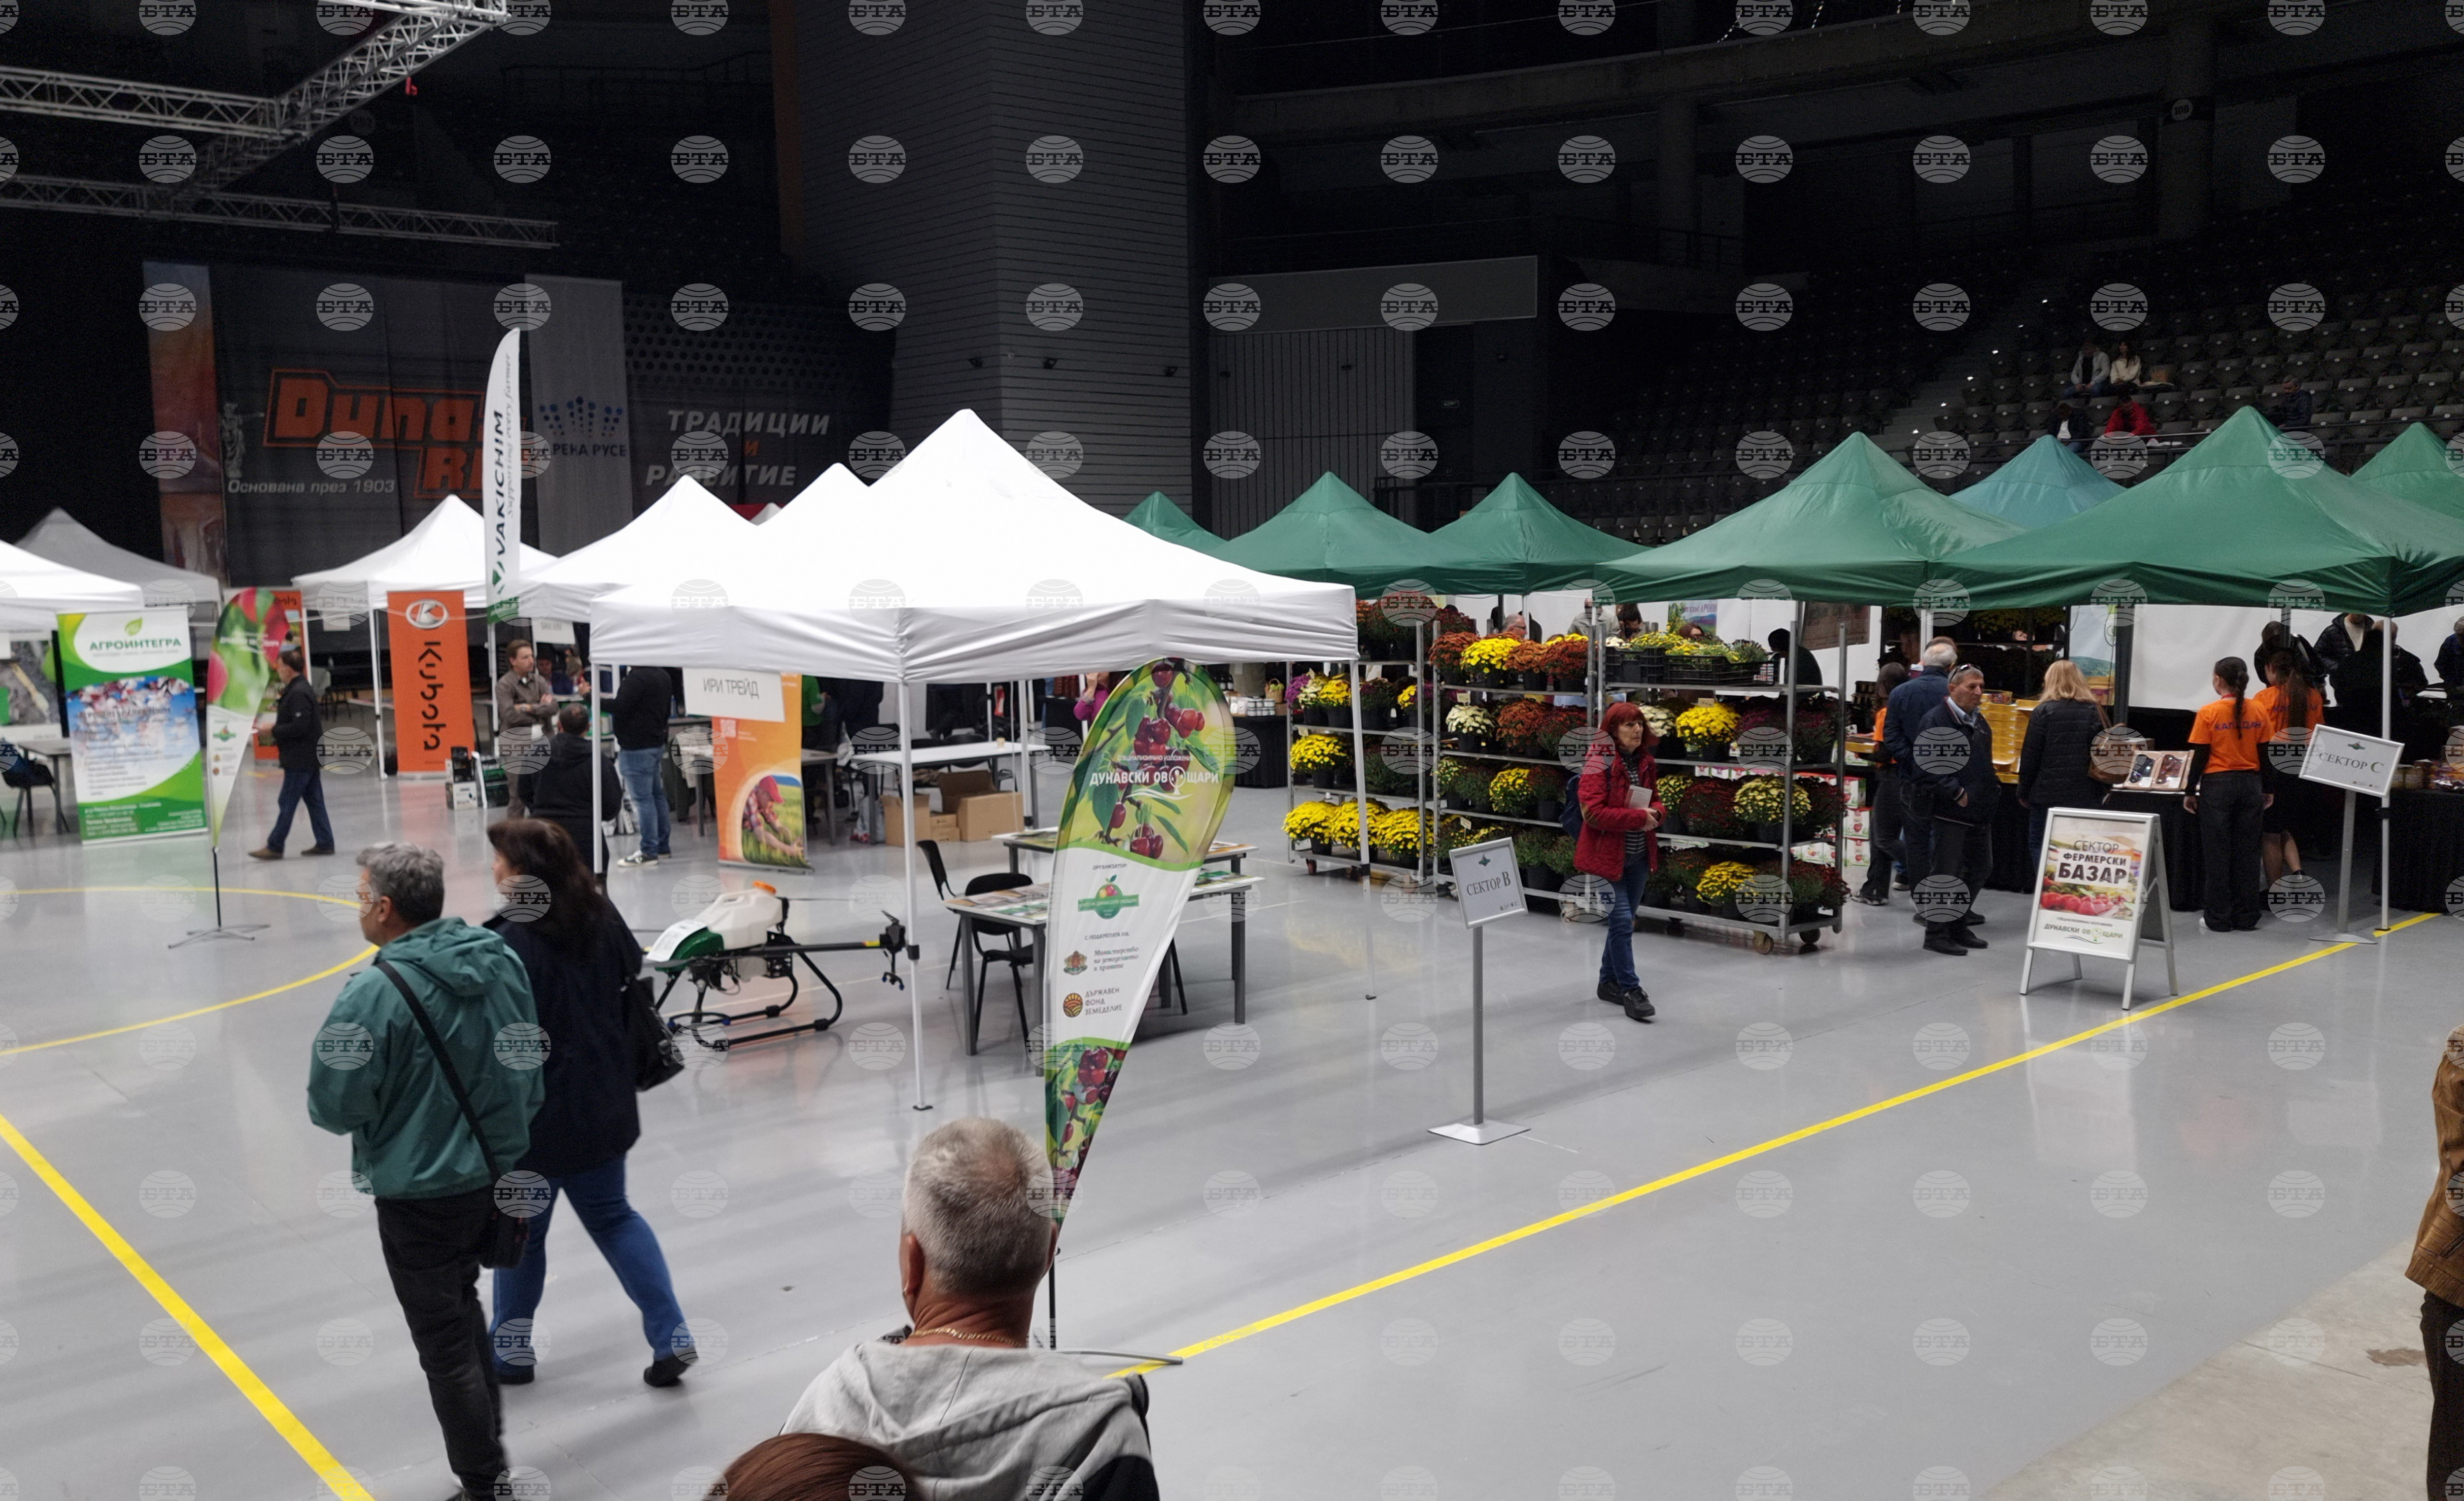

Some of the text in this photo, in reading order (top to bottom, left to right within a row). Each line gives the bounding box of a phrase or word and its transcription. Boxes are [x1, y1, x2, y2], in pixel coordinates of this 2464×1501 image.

[274, 377, 484, 442] Duna
[668, 410, 830, 438] ТРАДИЦИИ
[592, 443, 627, 456] РУСЕ
[228, 479, 305, 493] Основана
[353, 479, 395, 493] 1903
[493, 410, 506, 556] VAKICHIM
[89, 637, 182, 651] АГРОИНТЕГРА
[418, 642, 446, 751] Kubota
[703, 678, 723, 694] ИРИ
[725, 678, 760, 699] ТРЕЙД
[2319, 752, 2368, 770] СЕКТОР
[1089, 771, 1150, 787] ДУНАВСКИ
[2074, 839, 2120, 853] СЕКТОР
[2063, 852, 2127, 866] ФЕРМЕРСКИ
[2058, 862, 2127, 884] БАЗАР
[1467, 878, 1501, 896] СЕКТОР
[2044, 923, 2080, 933] ДУНАВСКИ
[1085, 987, 1120, 998] ДЪРЖАВЕН
[1085, 1004, 1123, 1016] ЗЕМЕДЕЛИЕ
